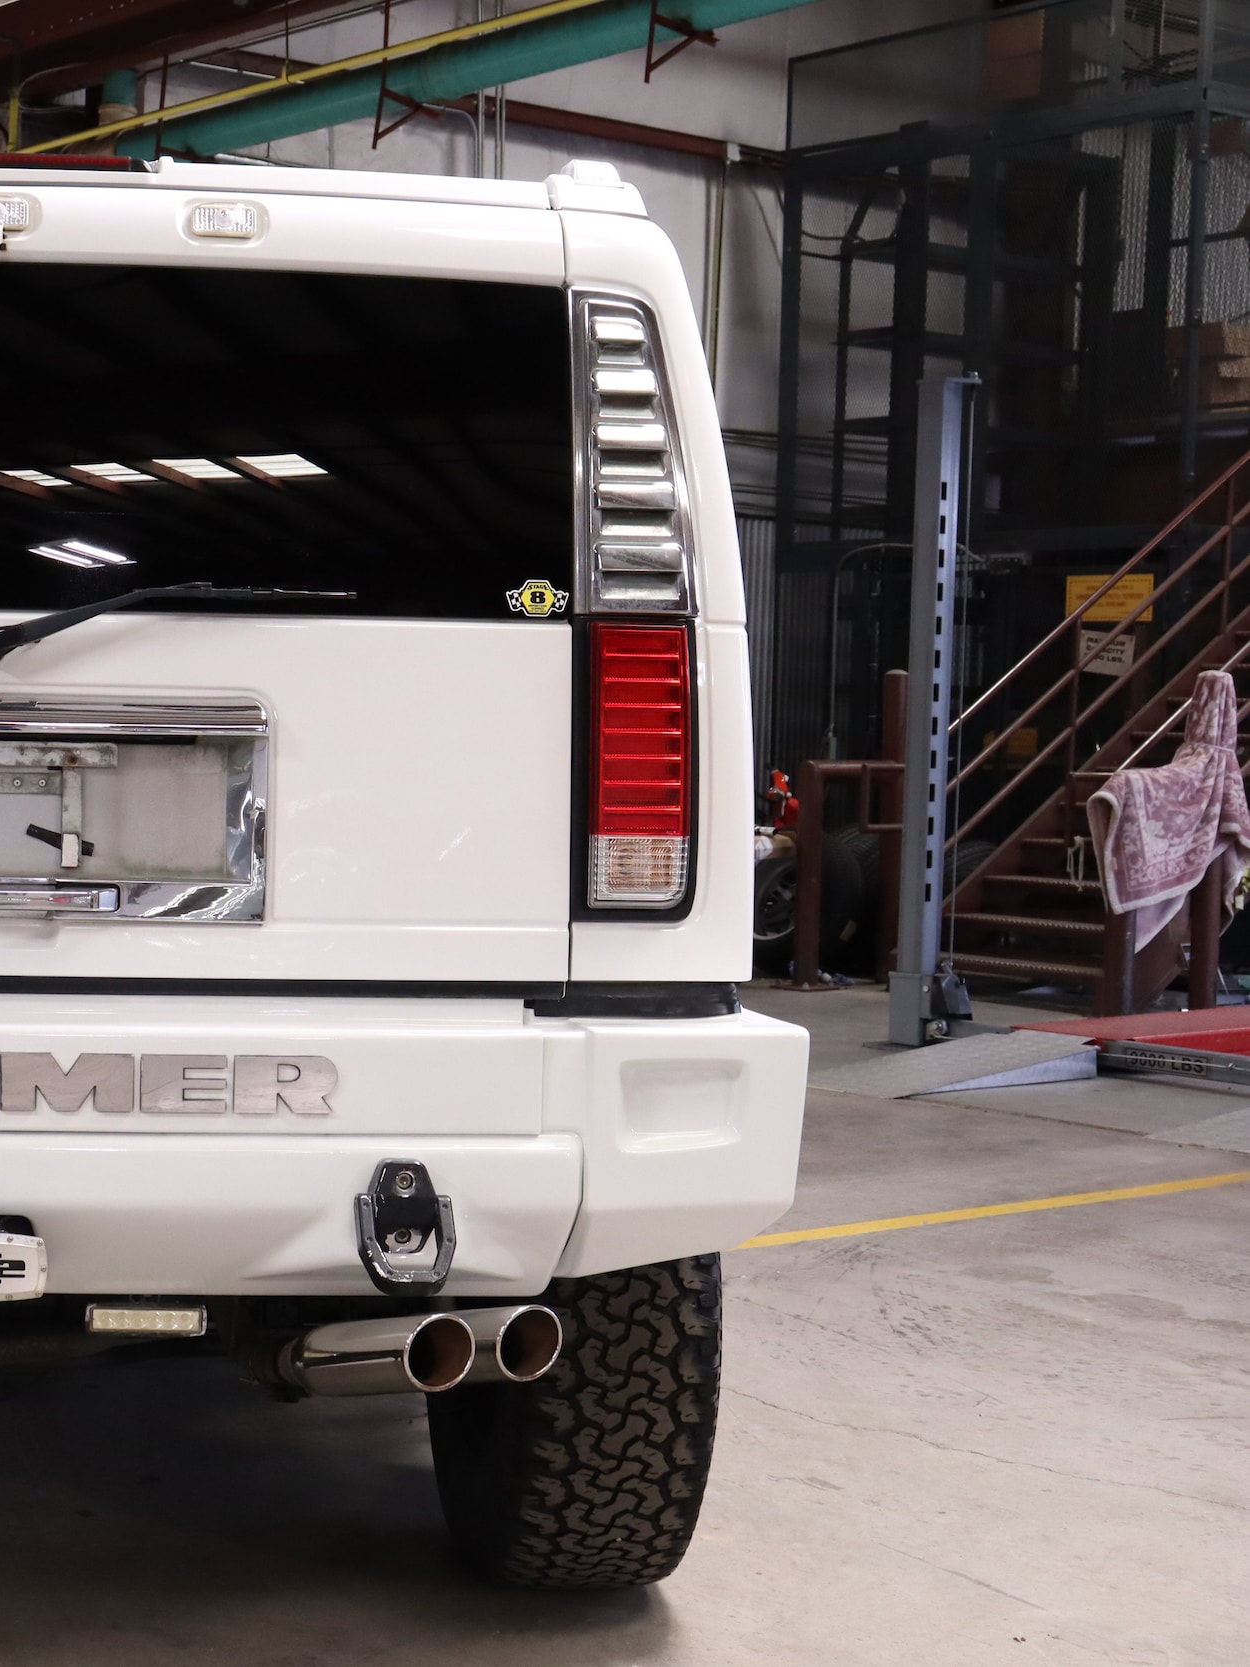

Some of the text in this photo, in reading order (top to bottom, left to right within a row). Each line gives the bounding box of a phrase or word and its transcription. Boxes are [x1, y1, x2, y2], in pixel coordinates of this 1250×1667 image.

[530, 591, 546, 604] 8
[1130, 1051, 1204, 1073] 9000 LBS
